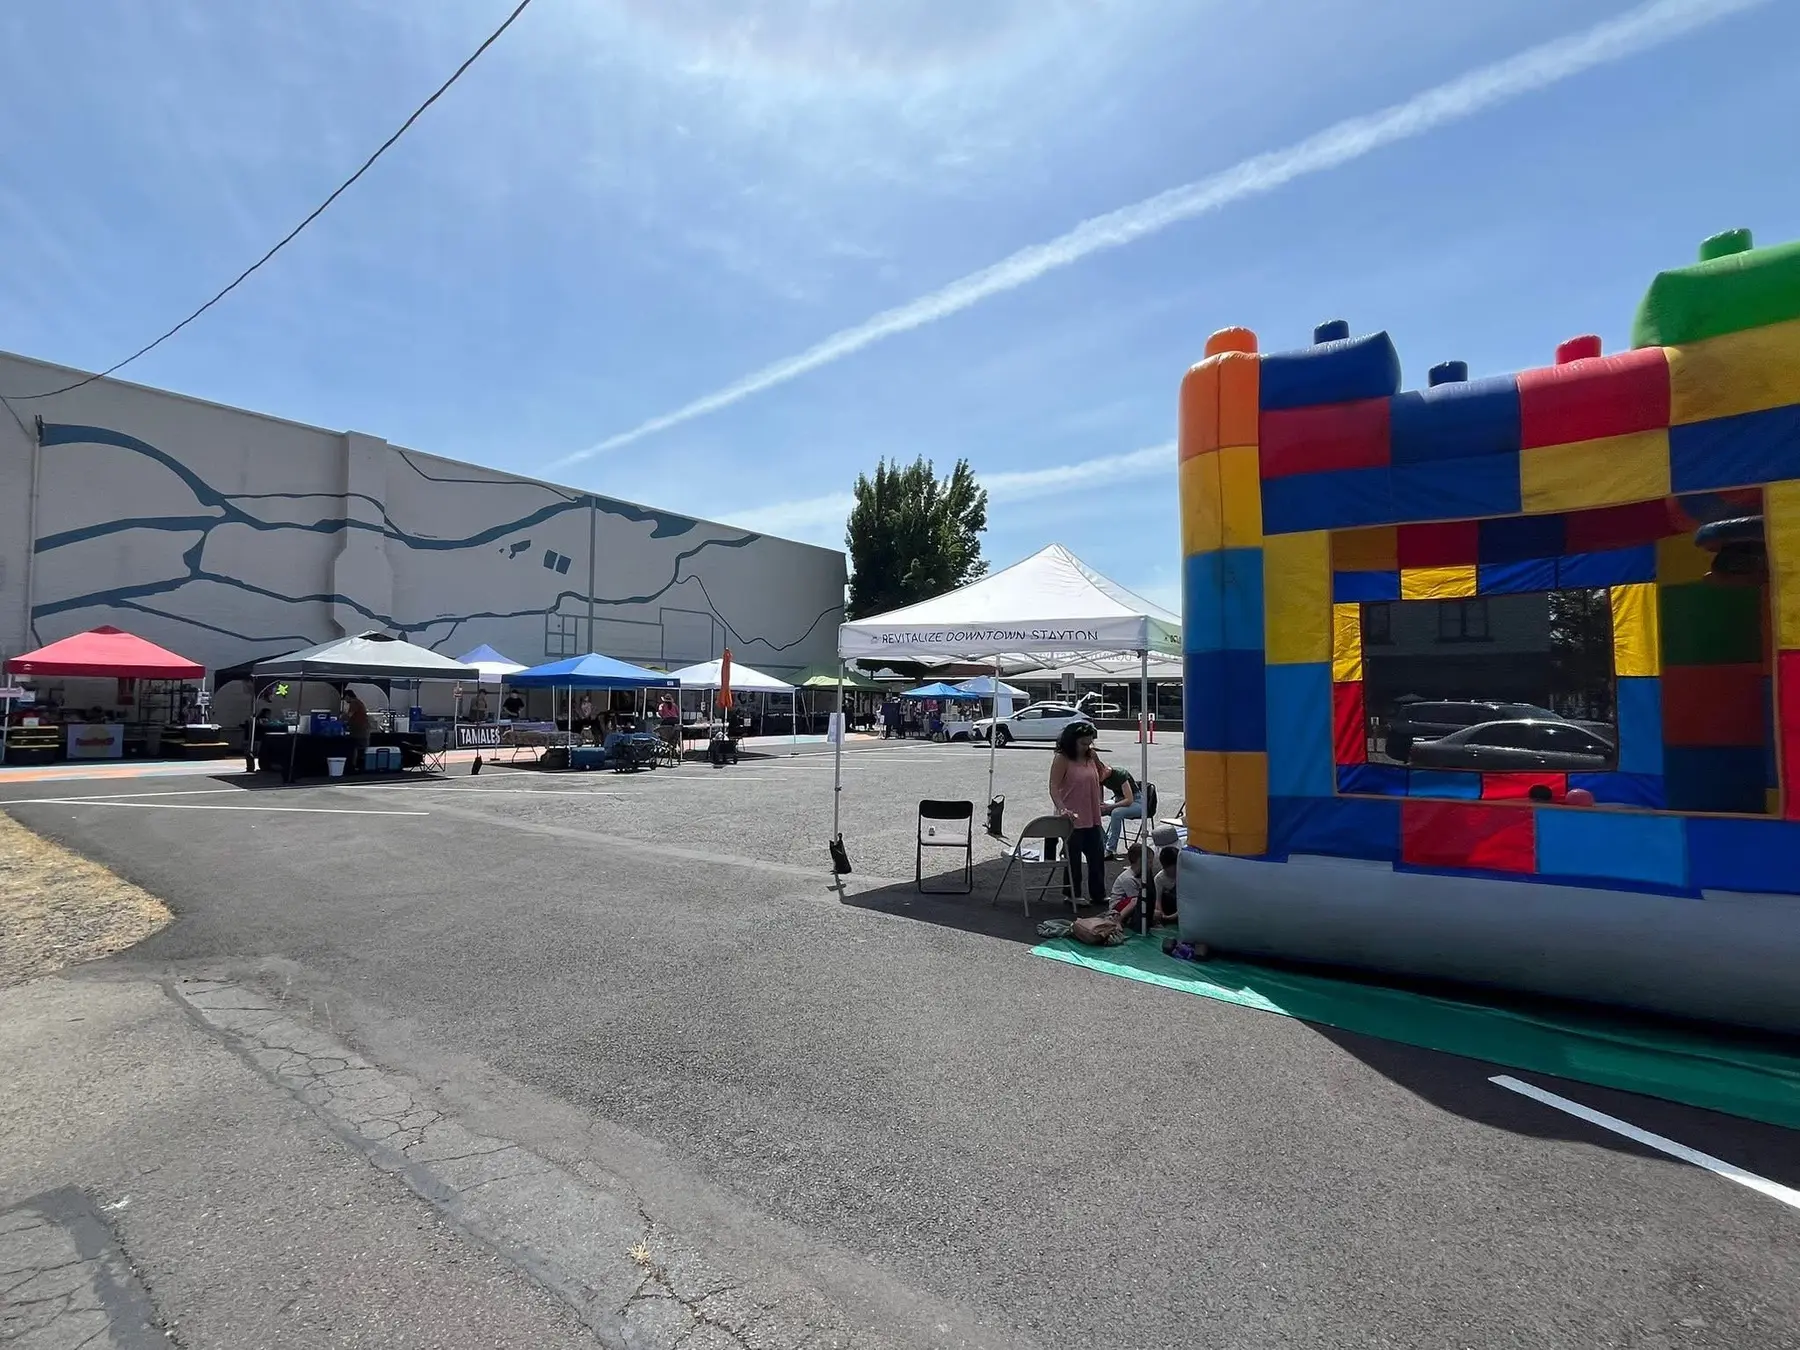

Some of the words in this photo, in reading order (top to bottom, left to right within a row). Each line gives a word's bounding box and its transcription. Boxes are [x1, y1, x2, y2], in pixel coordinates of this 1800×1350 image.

[882, 632, 943, 644] REVITALIZE
[946, 631, 1027, 642] DOWNTOWN
[1030, 629, 1099, 640] STAYTON
